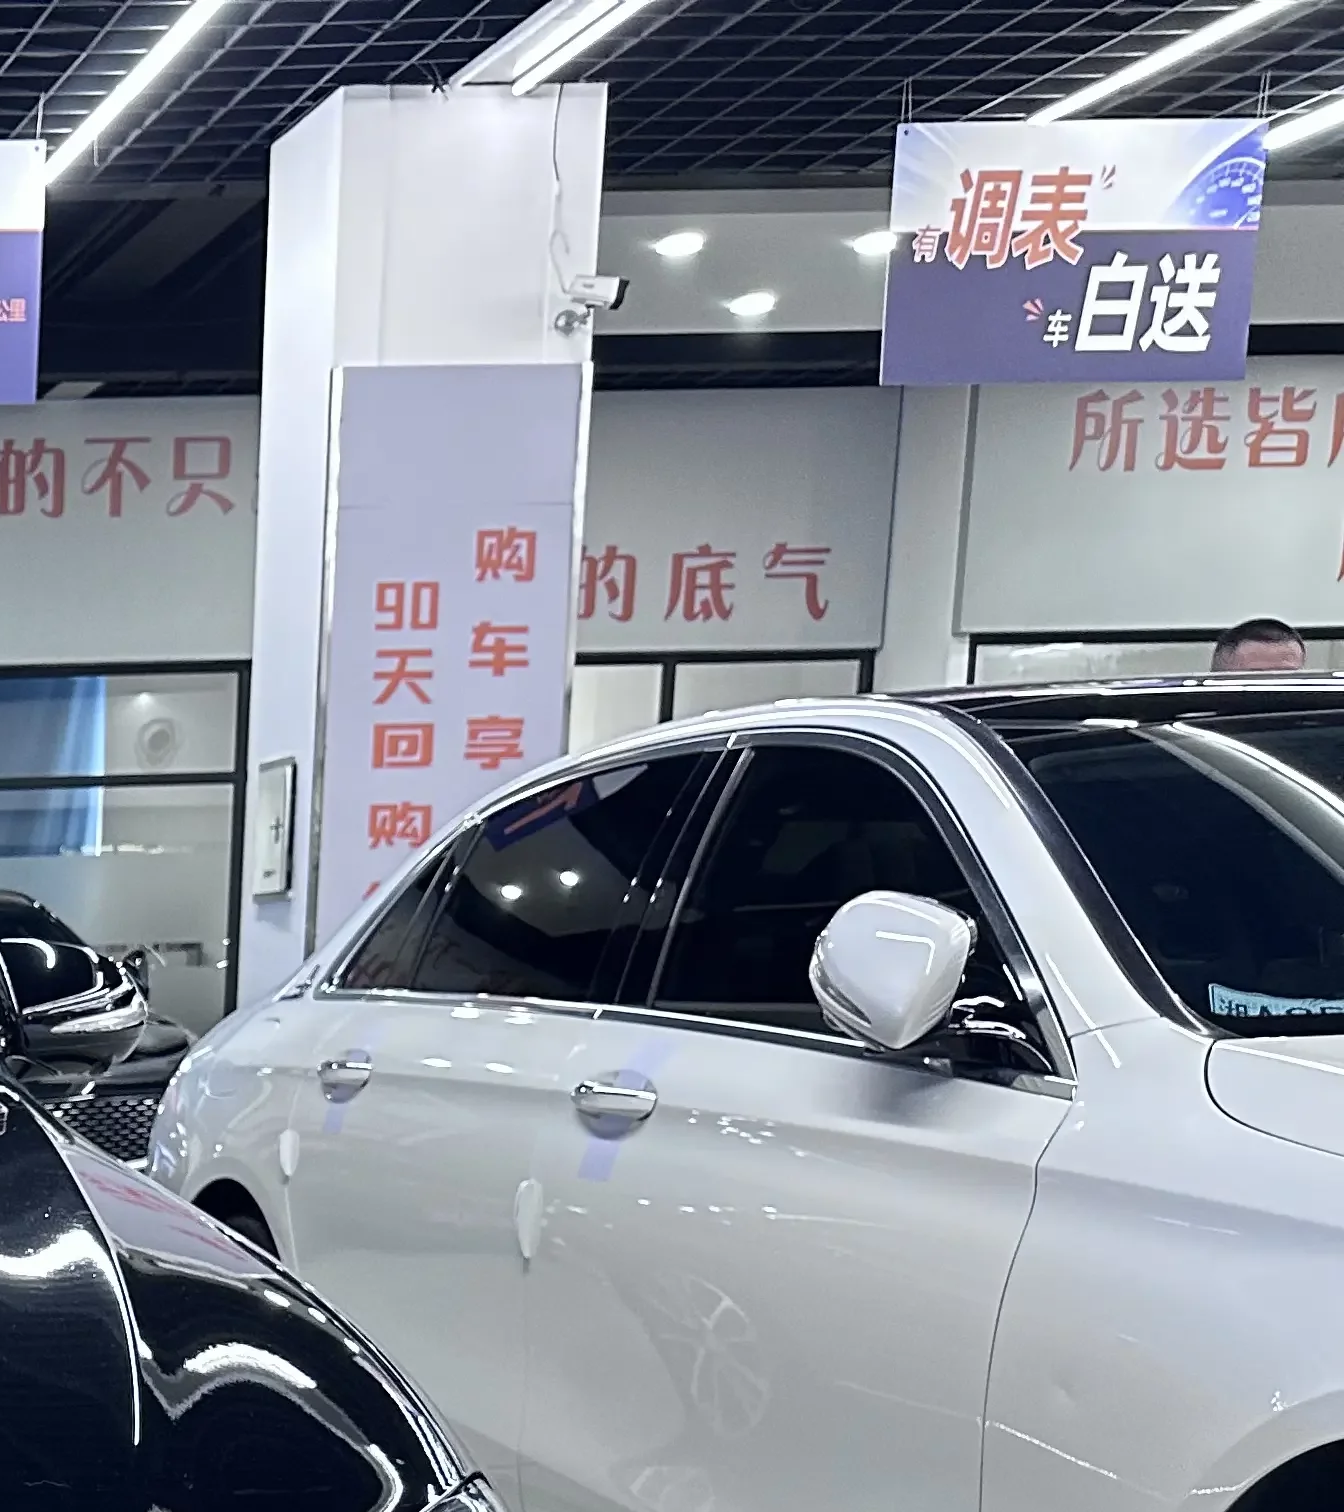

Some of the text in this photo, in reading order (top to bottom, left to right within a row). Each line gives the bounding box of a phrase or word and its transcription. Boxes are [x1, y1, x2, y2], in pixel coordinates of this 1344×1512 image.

[1068, 386, 1344, 473] 所选皆
[577, 541, 833, 623] 的底气
